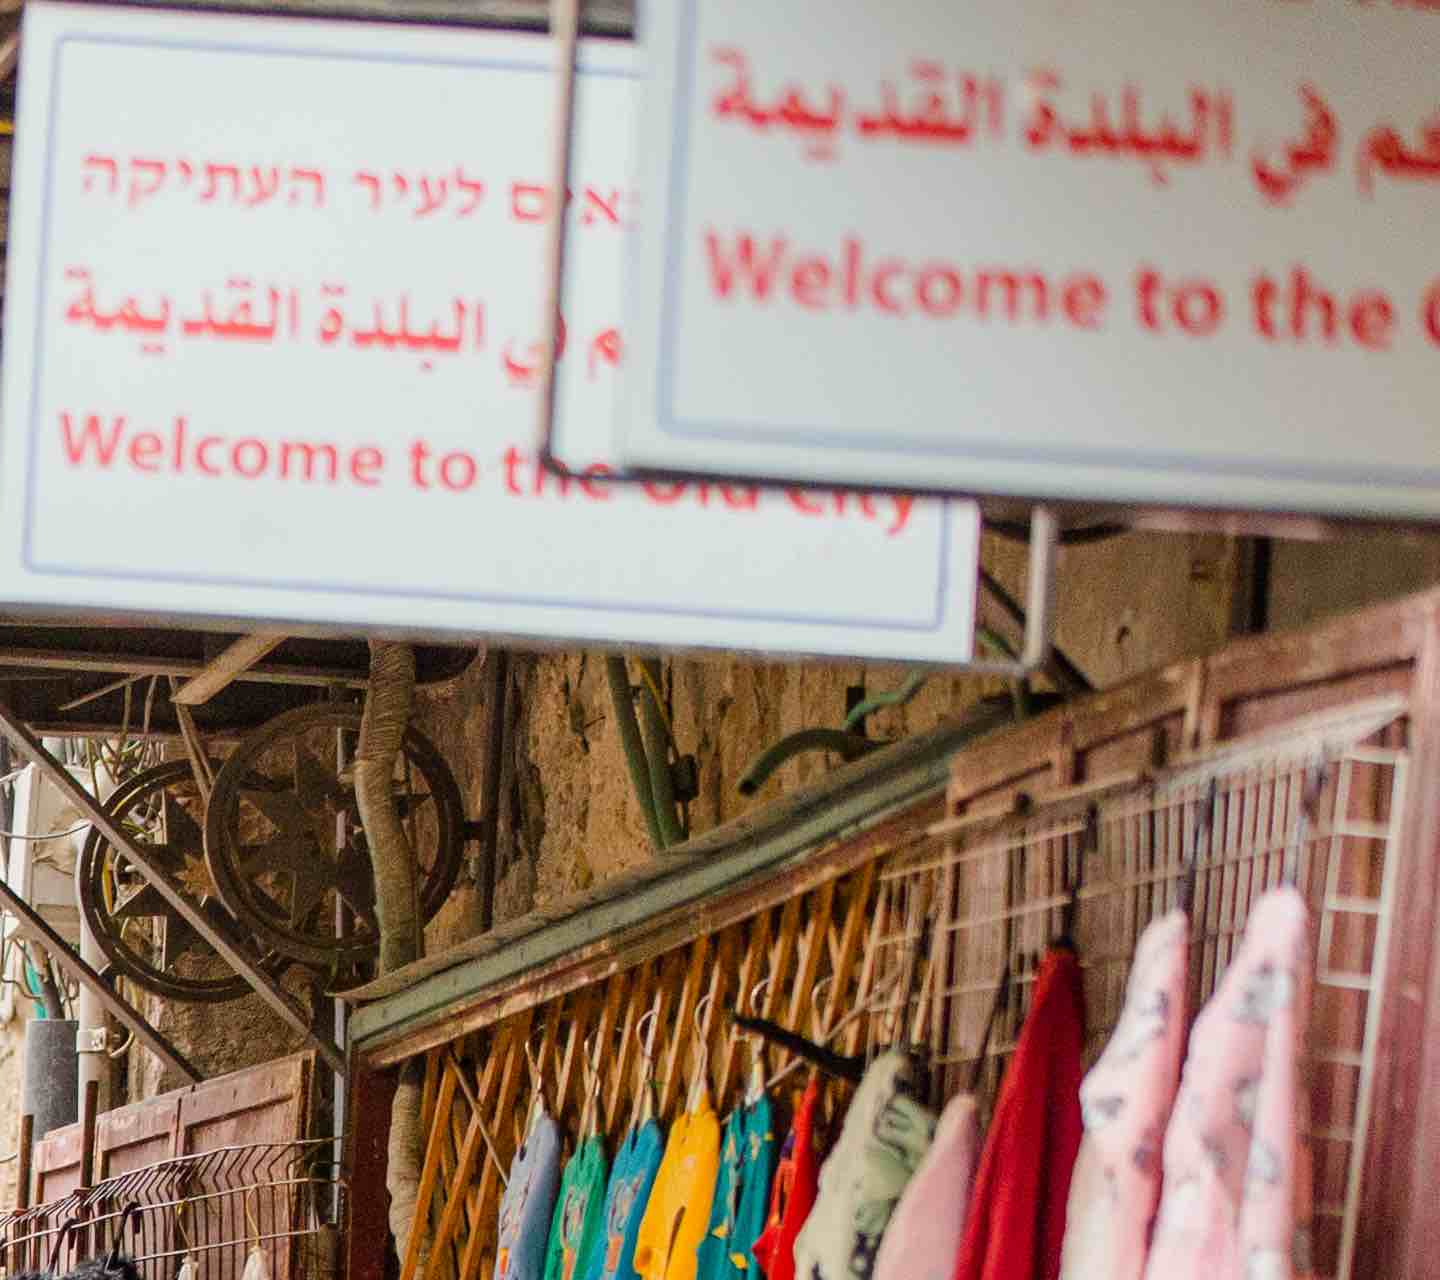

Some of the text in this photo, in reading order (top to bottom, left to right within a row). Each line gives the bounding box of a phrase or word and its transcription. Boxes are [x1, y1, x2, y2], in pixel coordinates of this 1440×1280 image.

[708, 44, 1005, 162] القديمة
[1024, 66, 1234, 188] البلدة
[81, 152, 327, 209] העתיקה
[351, 166, 486, 218] לעיר
[64, 262, 299, 355] القديمة
[317, 278, 486, 375] البلدة
[704, 225, 1111, 332] Welcome
[1133, 264, 1226, 338] to
[1247, 262, 1396, 353] the
[59, 409, 386, 489] Welcome
[408, 437, 479, 494] to
